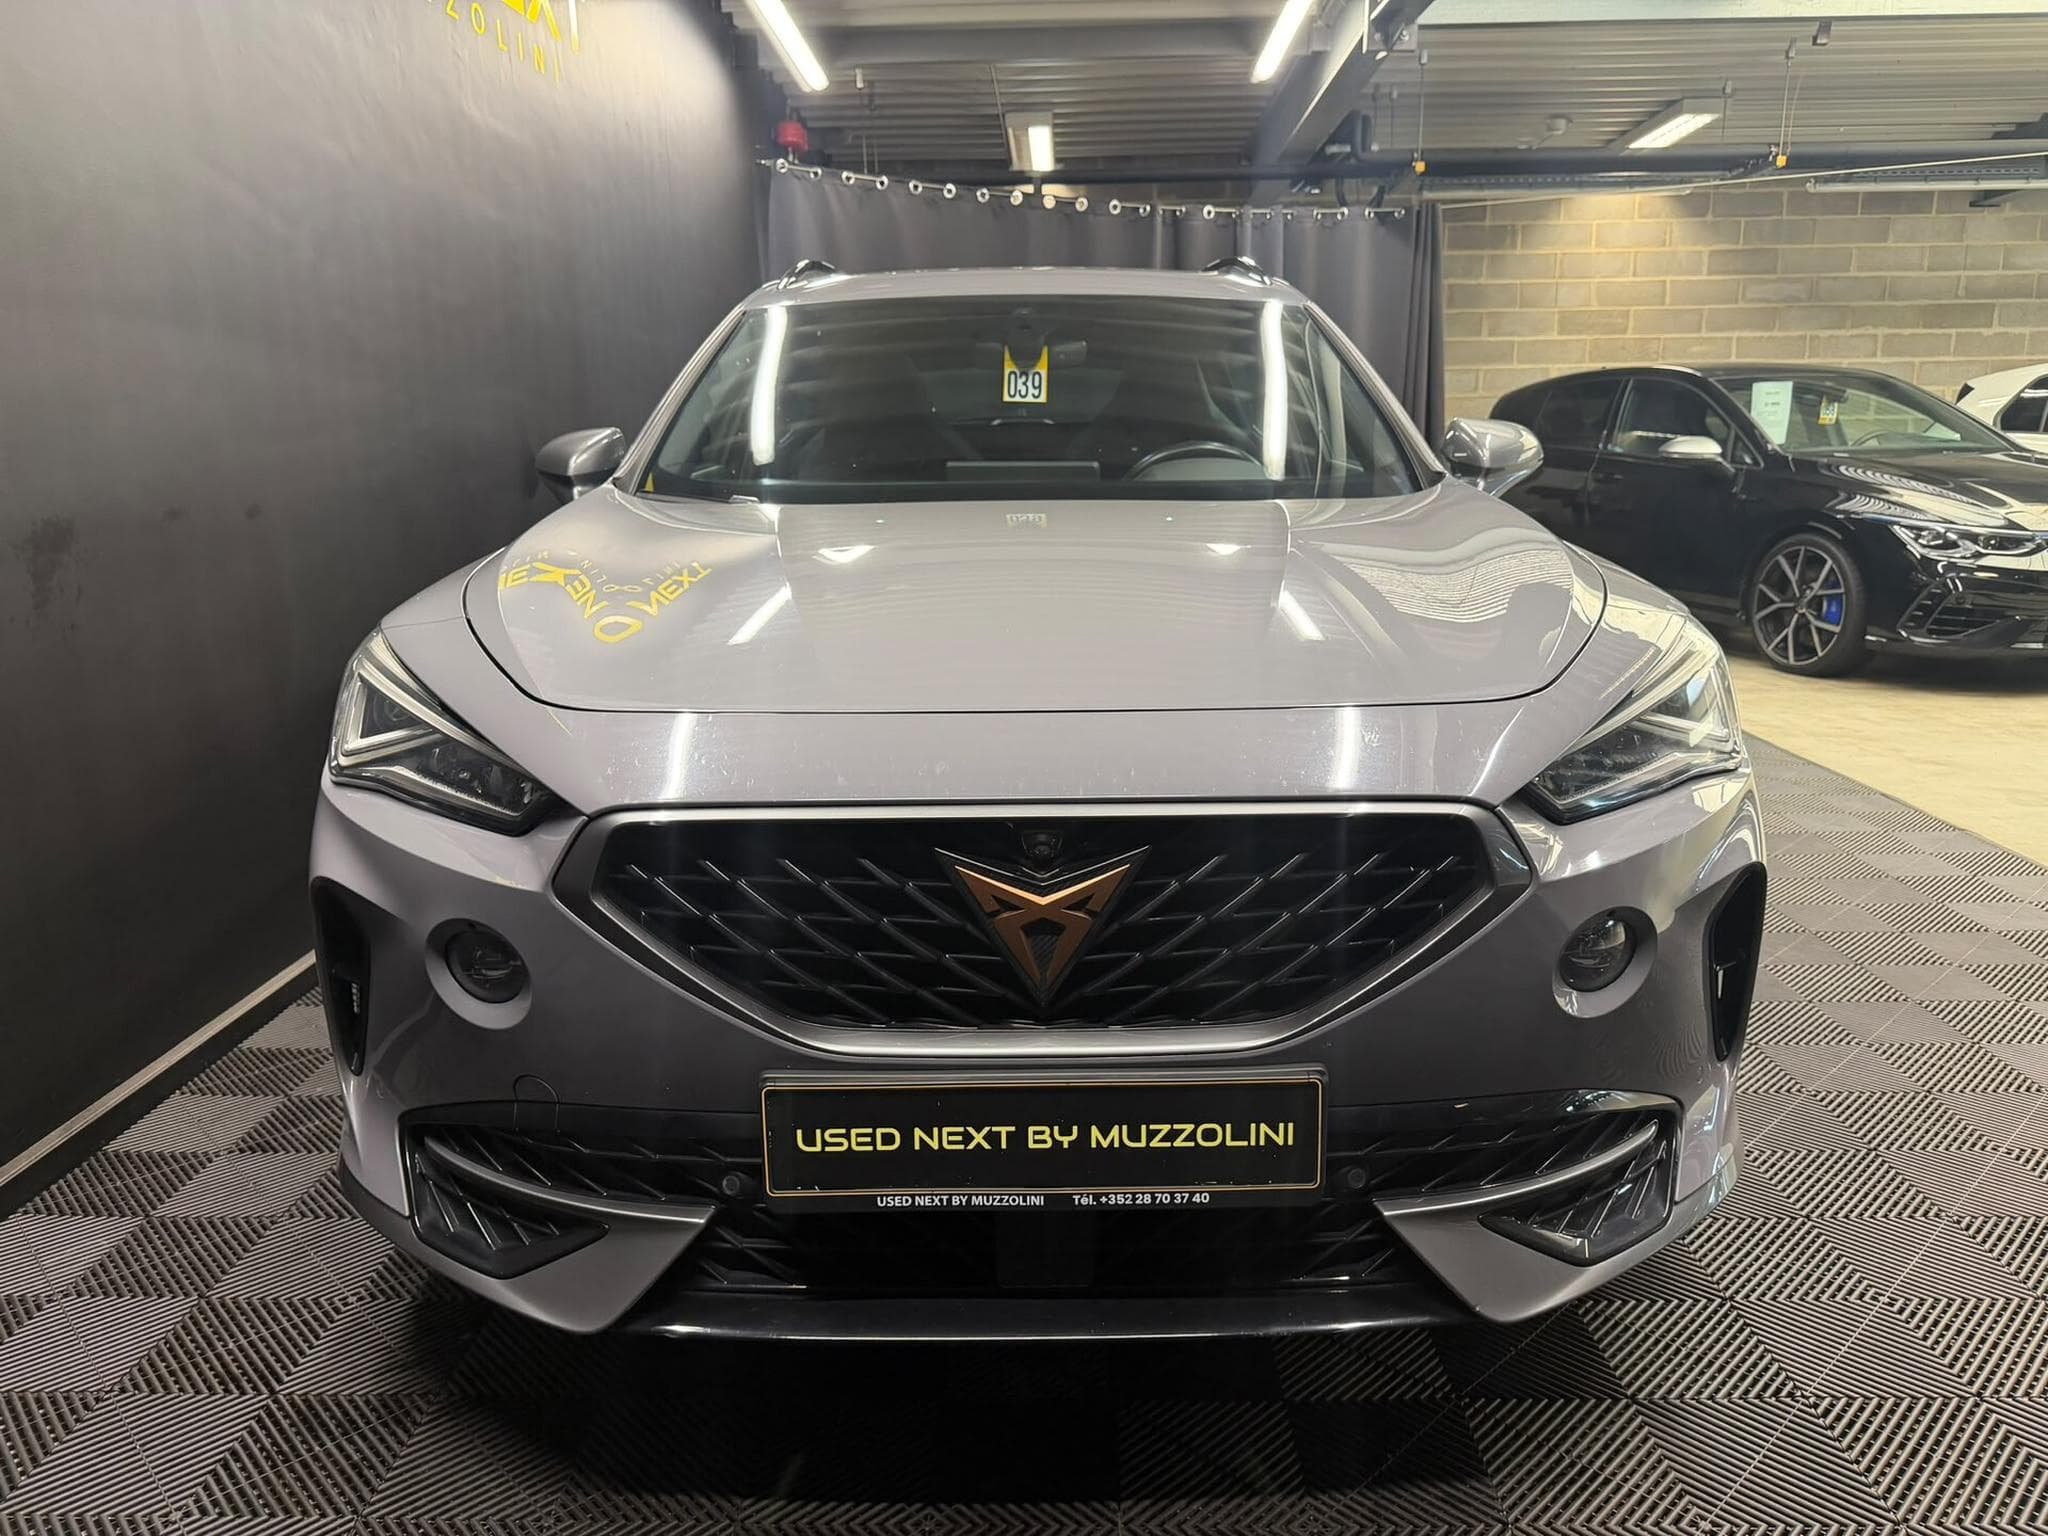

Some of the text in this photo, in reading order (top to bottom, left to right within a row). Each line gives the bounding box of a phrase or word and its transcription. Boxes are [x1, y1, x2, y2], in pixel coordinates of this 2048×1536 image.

[1007, 371, 1042, 399] 039
[796, 1122, 1294, 1152] USED NEXT BY MUZZOLINI
[876, 1194, 1045, 1208] USED NEXT BY MUZZOLINI
[1072, 1192, 1210, 1206] Tél. +352 28 70 37 40
